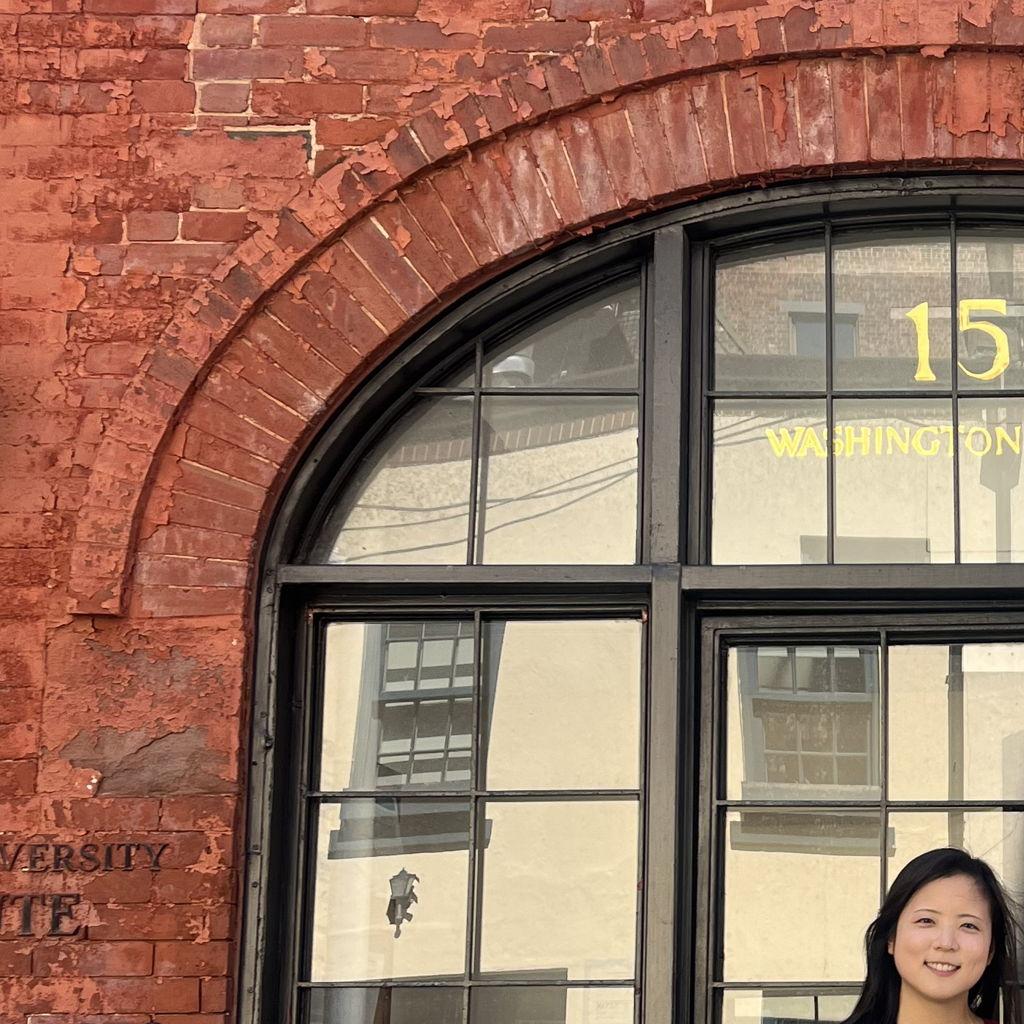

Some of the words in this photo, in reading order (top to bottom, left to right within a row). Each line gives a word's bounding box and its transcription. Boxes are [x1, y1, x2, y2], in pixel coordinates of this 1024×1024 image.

[905, 298, 1010, 382] 15
[765, 425, 1022, 458] WASHINGTON
[0, 843, 169, 873] VERSITY
[0, 893, 81, 937] TE
